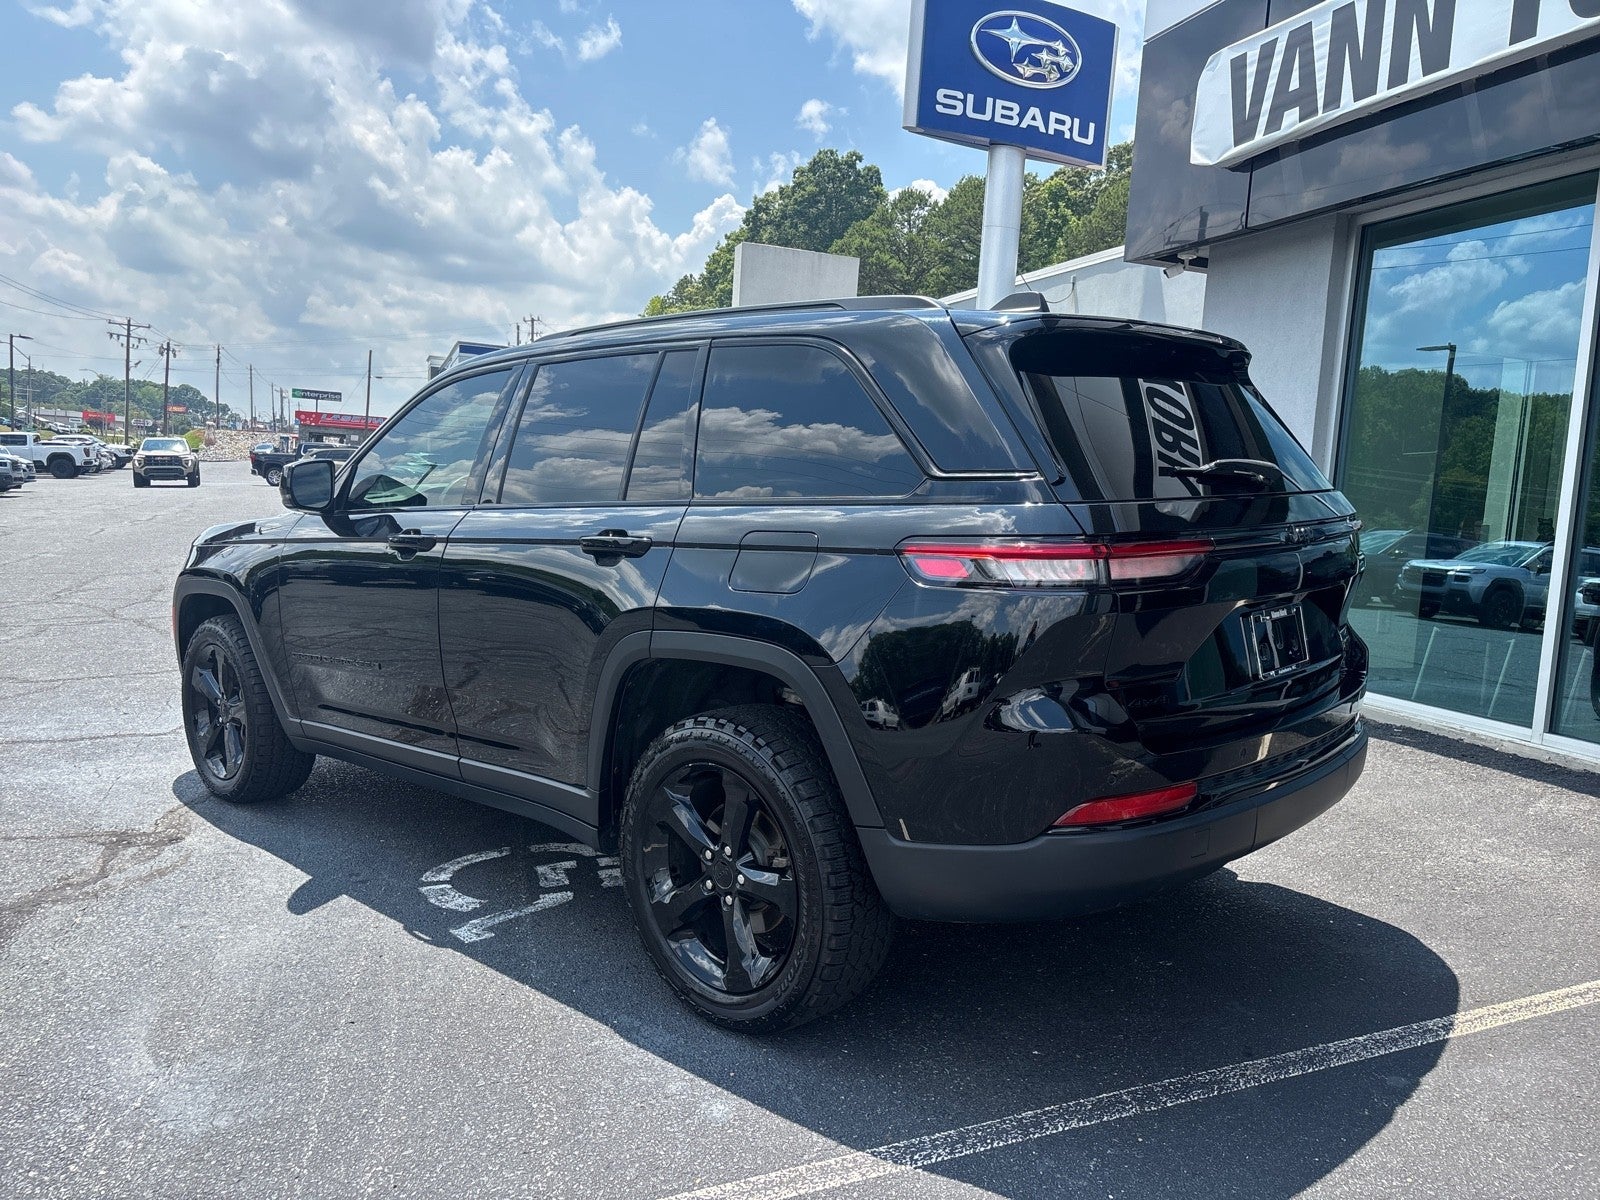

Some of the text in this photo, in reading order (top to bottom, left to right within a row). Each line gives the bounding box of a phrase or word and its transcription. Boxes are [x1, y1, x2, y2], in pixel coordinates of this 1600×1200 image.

[1230, 0, 1456, 148] VANN
[935, 88, 1095, 146] SUBARU
[294, 390, 341, 399] enterprise
